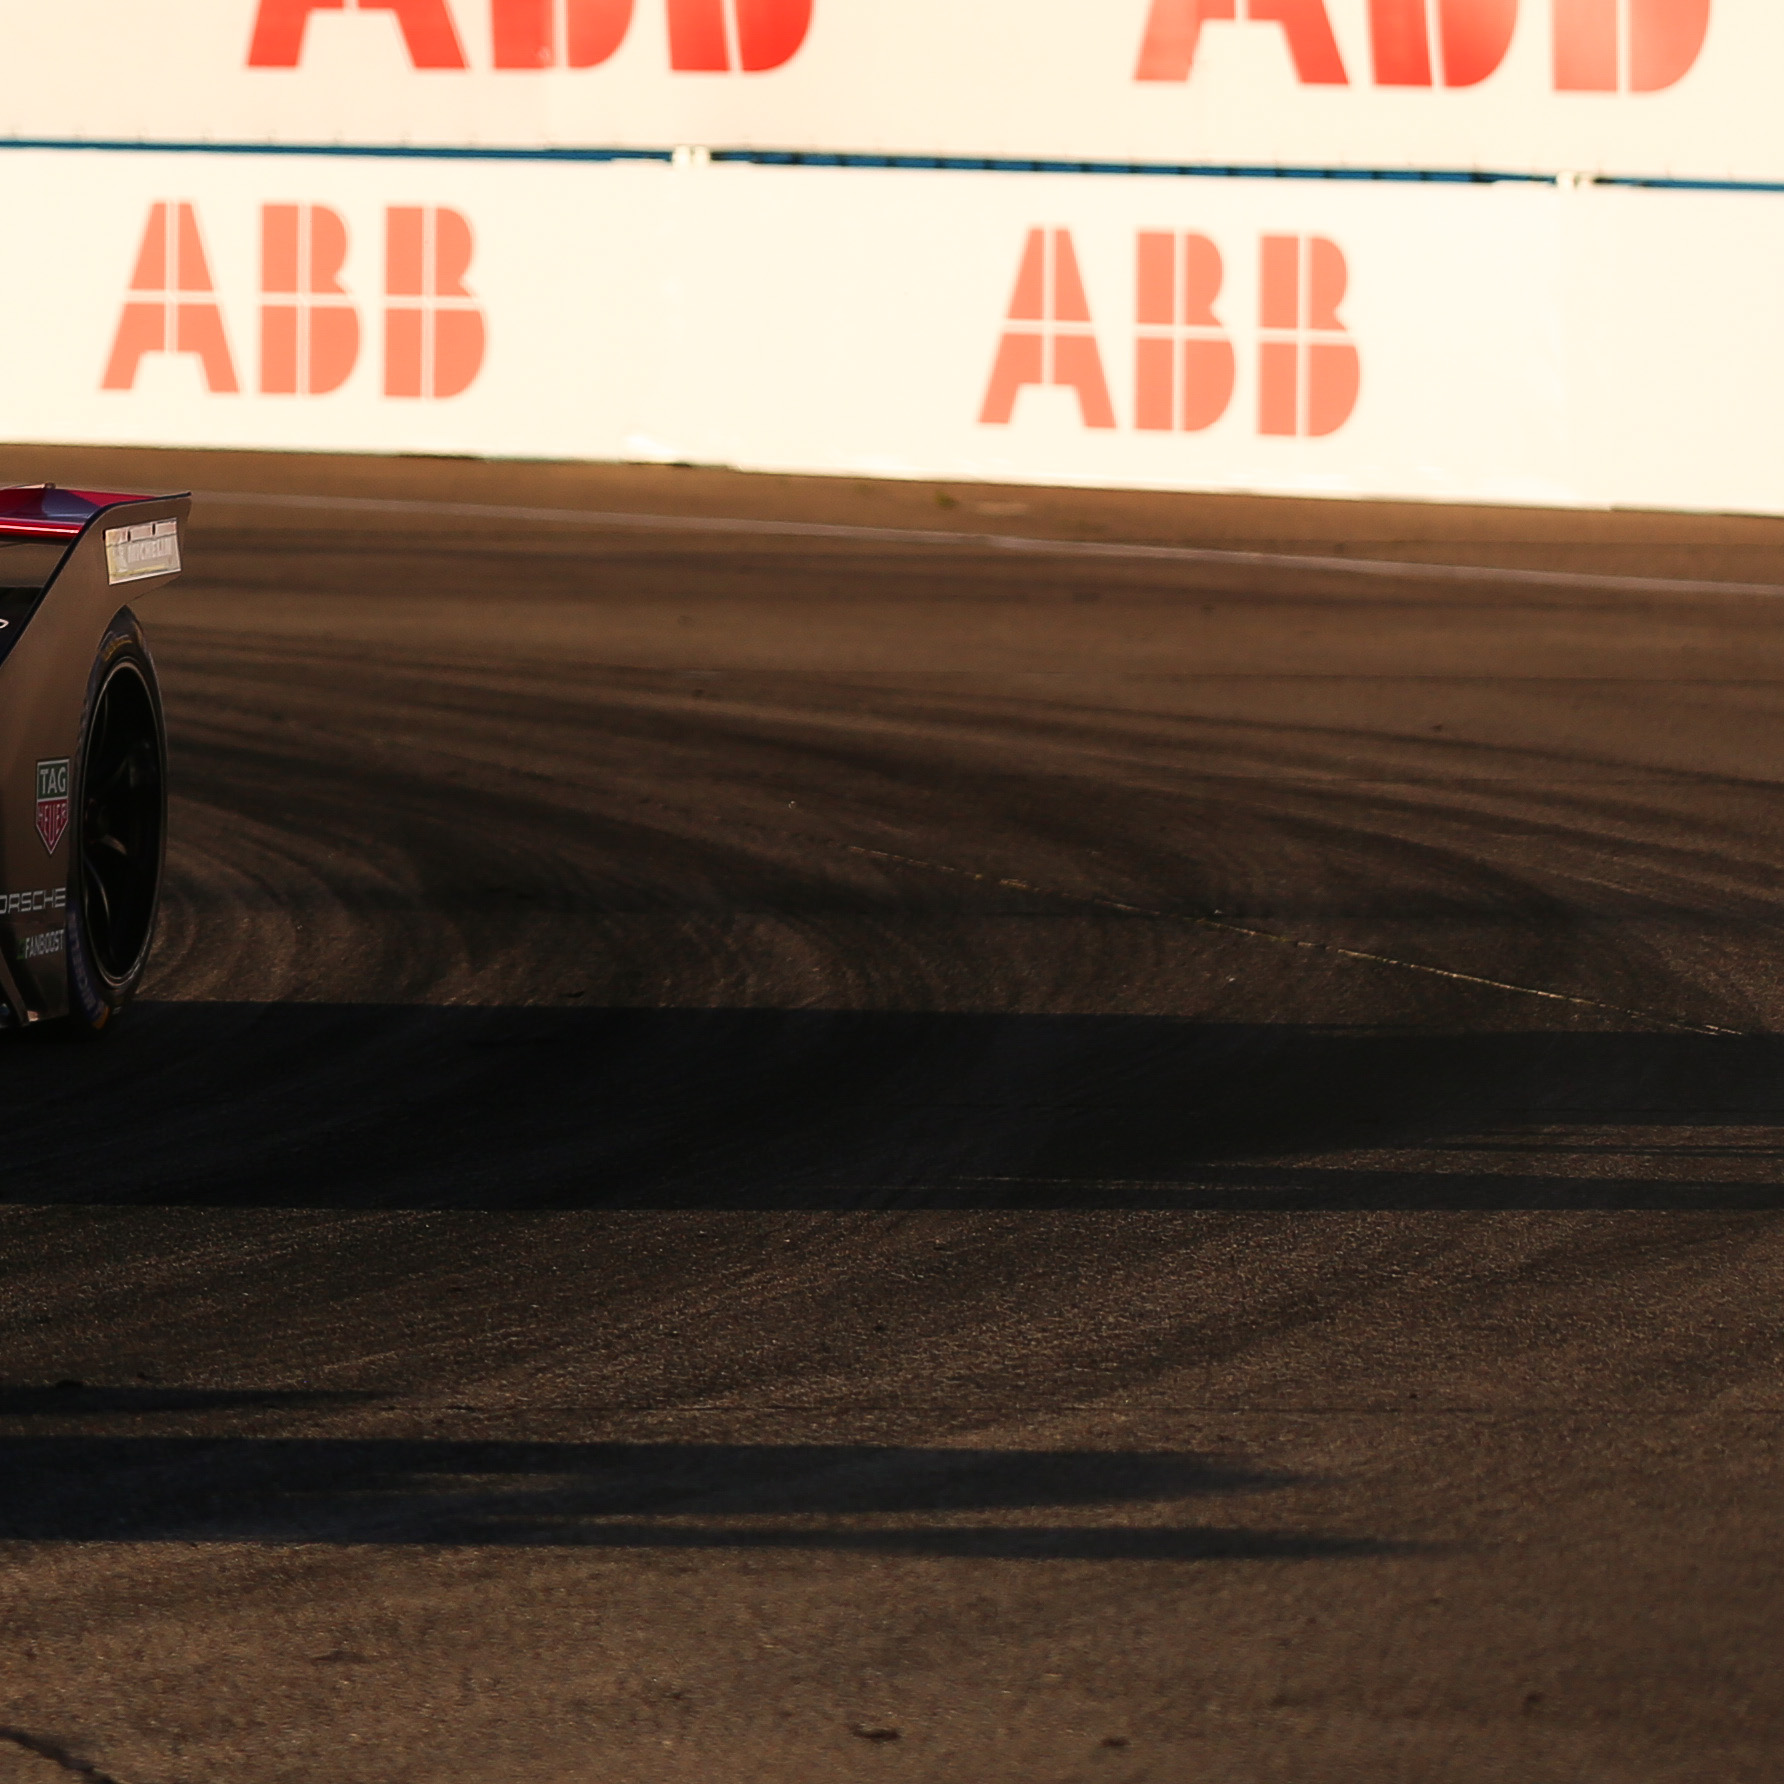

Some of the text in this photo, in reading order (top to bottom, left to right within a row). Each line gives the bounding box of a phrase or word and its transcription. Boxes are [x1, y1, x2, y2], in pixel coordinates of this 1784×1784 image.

[101, 201, 485, 399] ABB
[977, 228, 1361, 437] ABB
[40, 767, 67, 795] TAG
